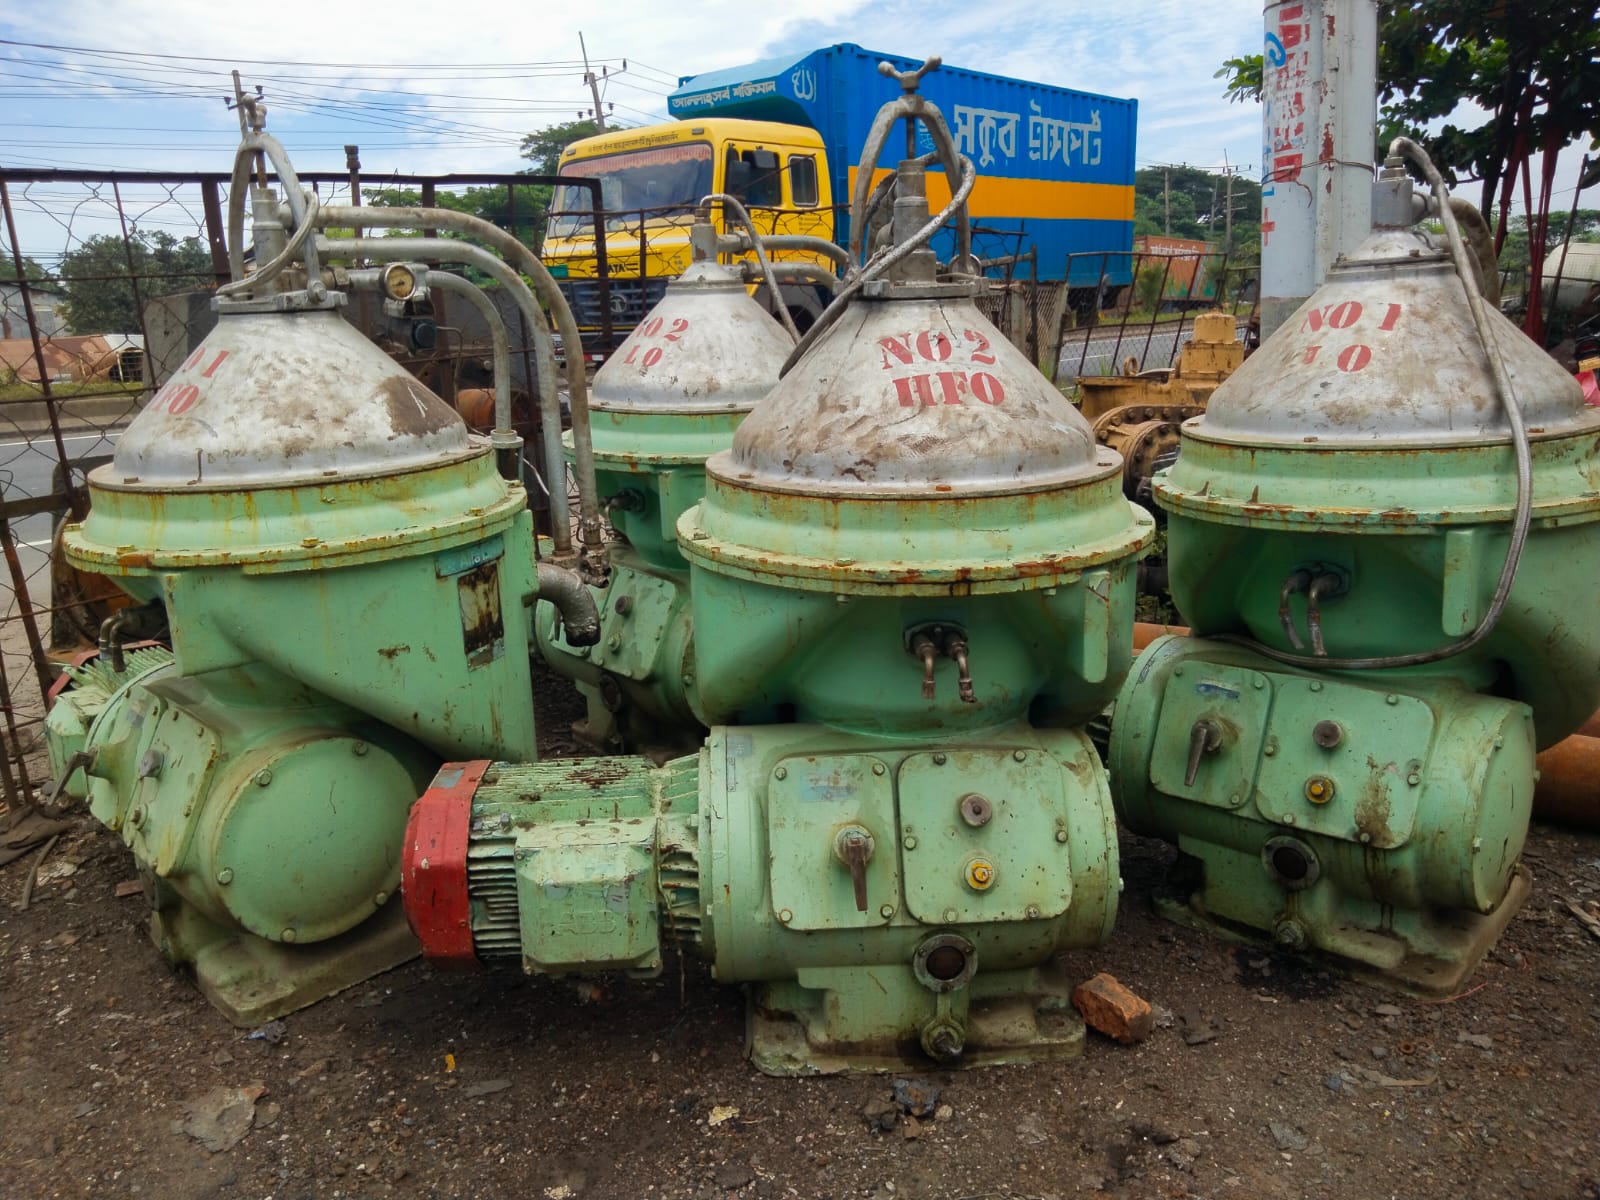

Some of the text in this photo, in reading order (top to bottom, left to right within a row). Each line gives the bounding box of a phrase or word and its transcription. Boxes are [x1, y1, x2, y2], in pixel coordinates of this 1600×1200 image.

[664, 317, 689, 342] 2
[1300, 300, 1402, 334] NO 1
[877, 329, 996, 370] NO 2
[892, 371, 1005, 407] HFO
